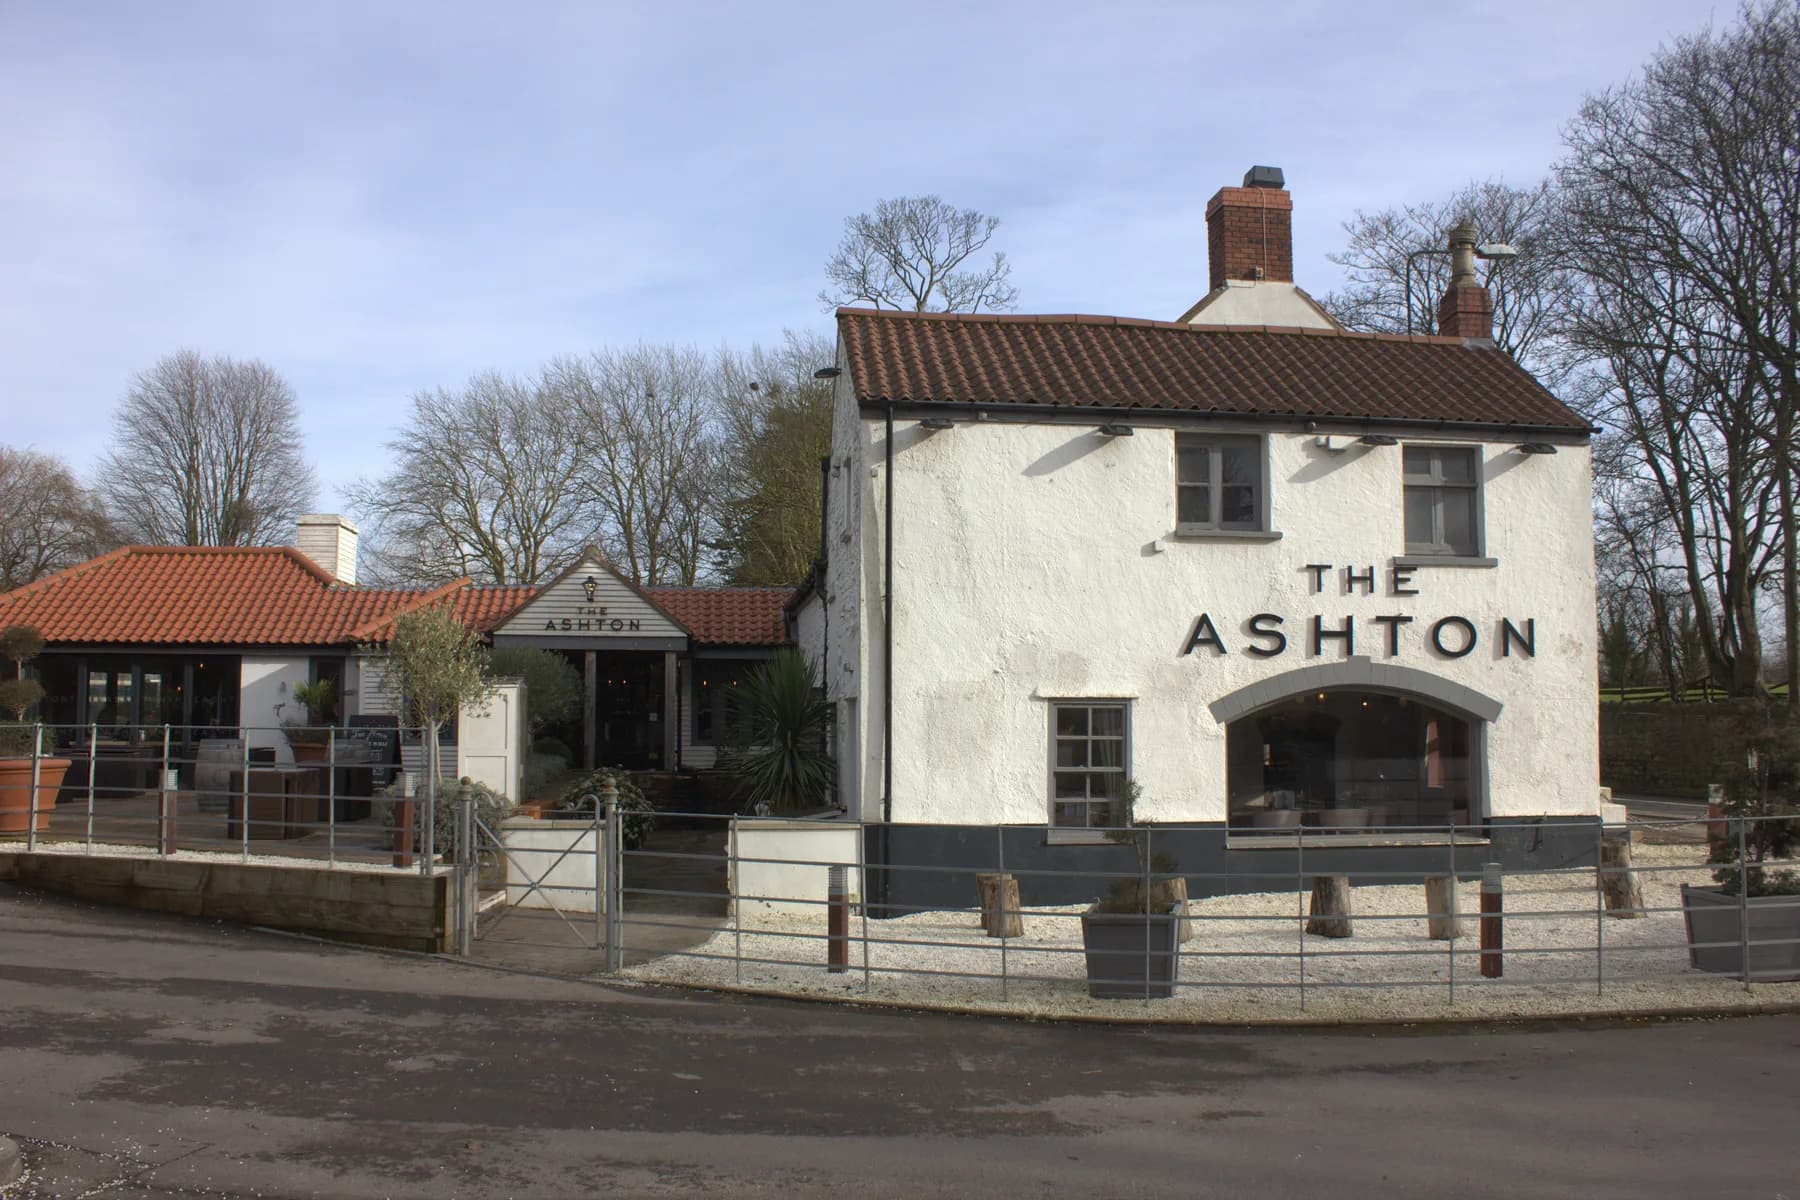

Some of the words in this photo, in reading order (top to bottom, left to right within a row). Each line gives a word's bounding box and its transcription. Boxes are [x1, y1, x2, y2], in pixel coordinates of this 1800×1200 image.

[1306, 563, 1419, 595] THE
[577, 607, 608, 616] THE
[544, 618, 640, 631] ASHTON
[1184, 612, 1536, 658] ASHTON
